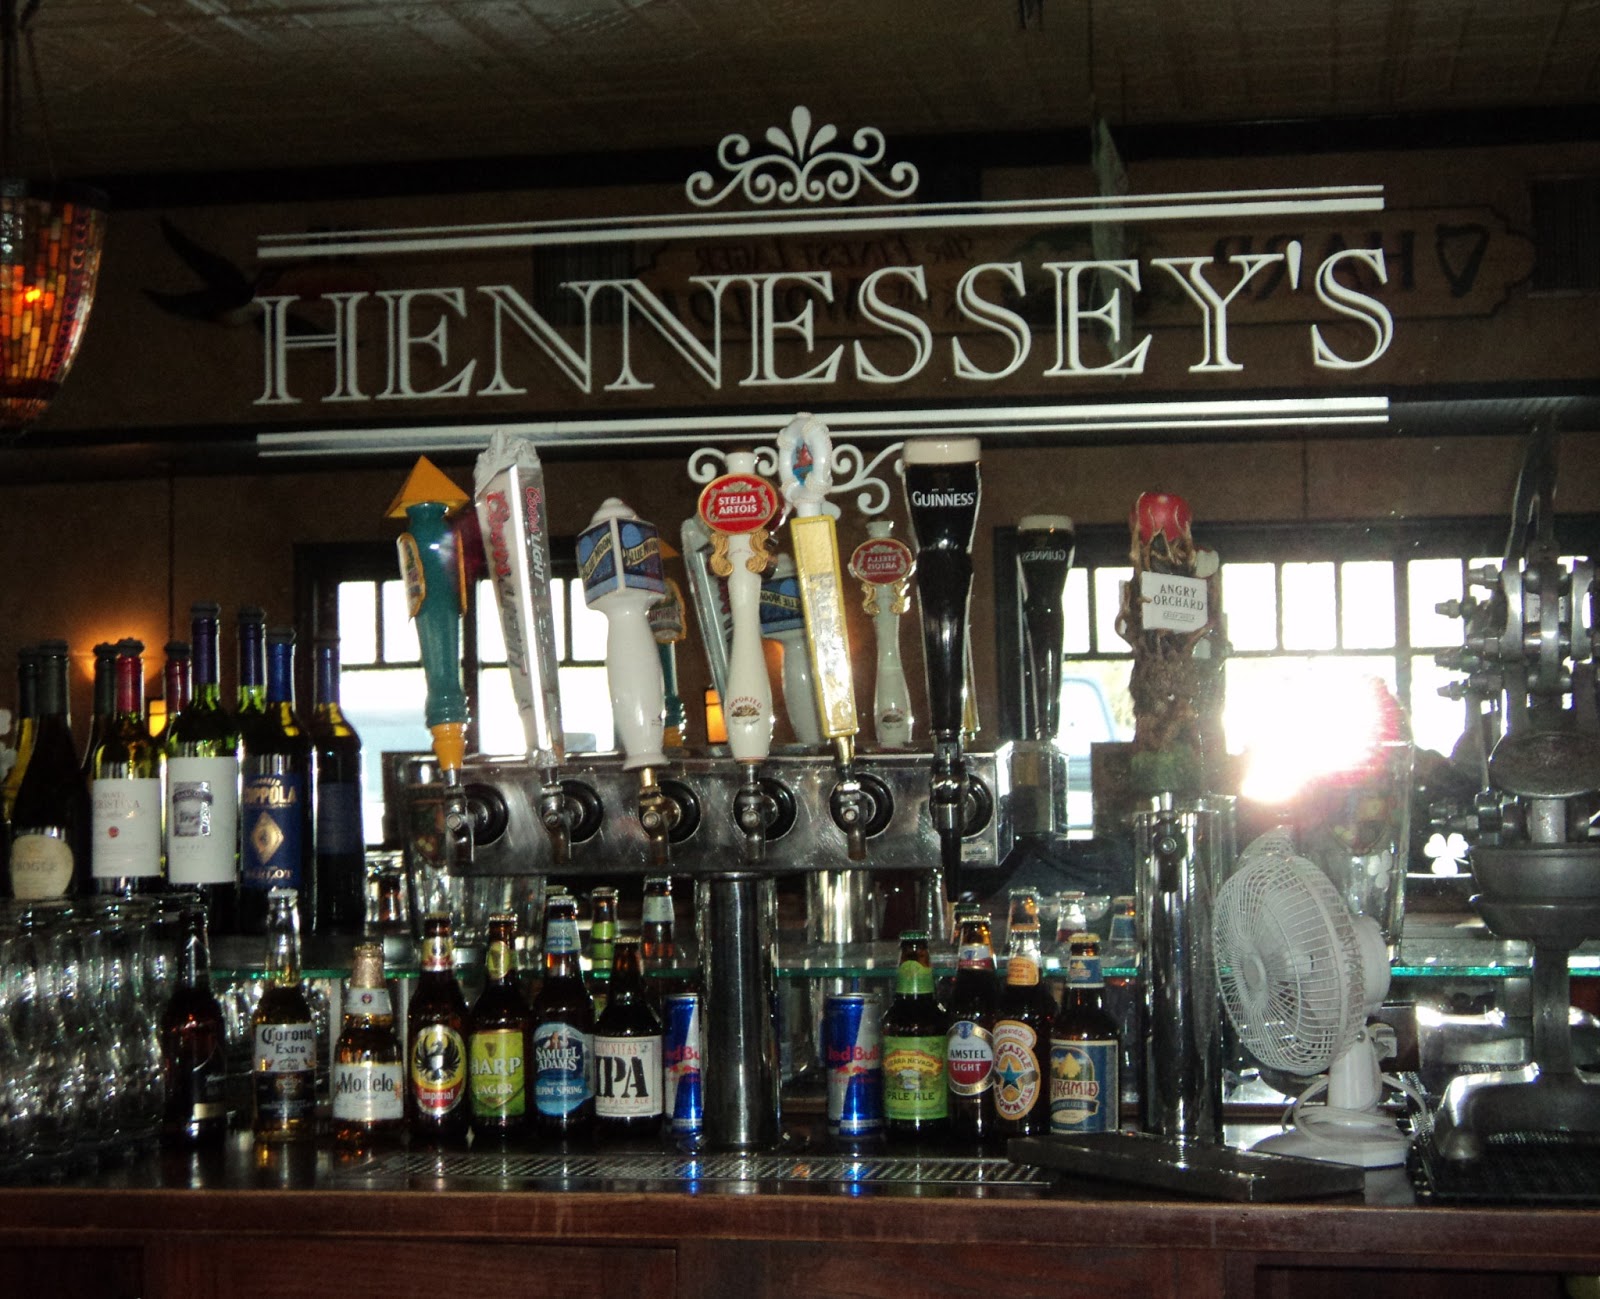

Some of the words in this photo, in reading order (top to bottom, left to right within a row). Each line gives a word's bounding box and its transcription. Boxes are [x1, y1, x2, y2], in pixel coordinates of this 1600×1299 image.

[252, 241, 1394, 405] HENNESSEY'S
[718, 495, 757, 506] STELLA
[911, 490, 975, 507] GUINNESS
[526, 486, 543, 534] Coors
[718, 504, 758, 515] ARTOIS
[530, 531, 545, 584] LIGHT
[1160, 584, 1197, 599] ANGRY
[1153, 594, 1204, 611] ORCHARD
[275, 1043, 306, 1054] Extra
[535, 1047, 581, 1061] SAMUEL
[950, 1049, 986, 1059] AMSTEL
[472, 1056, 522, 1076] HARP
[537, 1058, 577, 1071] ADAMS
[907, 1058, 934, 1068] NEVADA
[953, 1062, 982, 1072] LIGHT
[595, 1056, 649, 1098] IPA
[475, 1082, 514, 1095] LAGER
[556, 1083, 583, 1097] SPRING
[420, 1088, 454, 1107] Imperial
[888, 1091, 910, 1101] PALE
[914, 1091, 935, 1101] ALE
